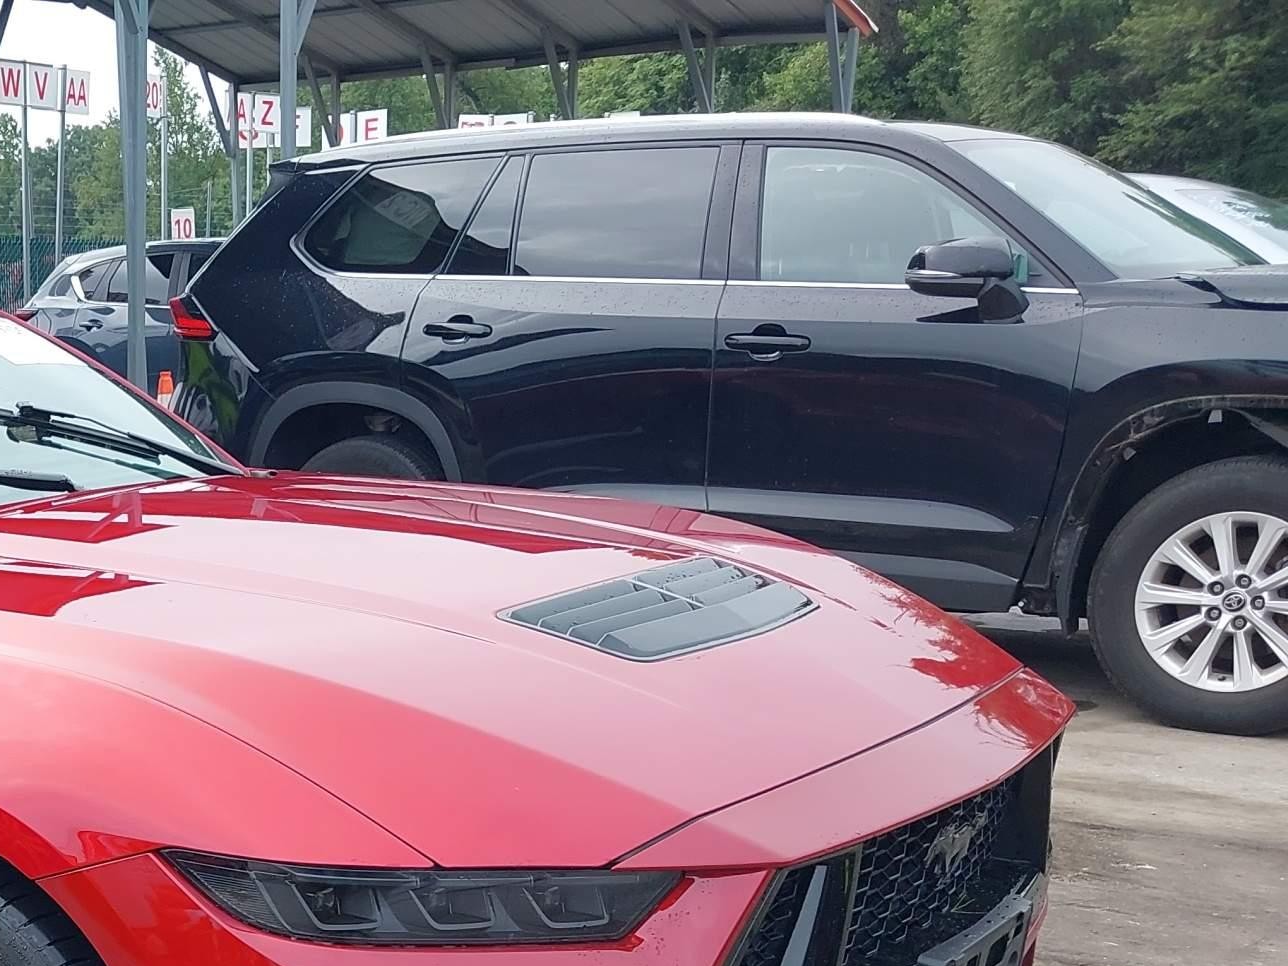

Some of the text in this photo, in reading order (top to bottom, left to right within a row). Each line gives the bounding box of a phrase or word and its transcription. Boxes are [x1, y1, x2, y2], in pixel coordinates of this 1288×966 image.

[0, 67, 21, 98] W
[34, 71, 48, 100] V
[66, 77, 87, 107] AA
[261, 100, 274, 126] Z
[365, 117, 379, 141] E
[174, 217, 192, 239] 10
